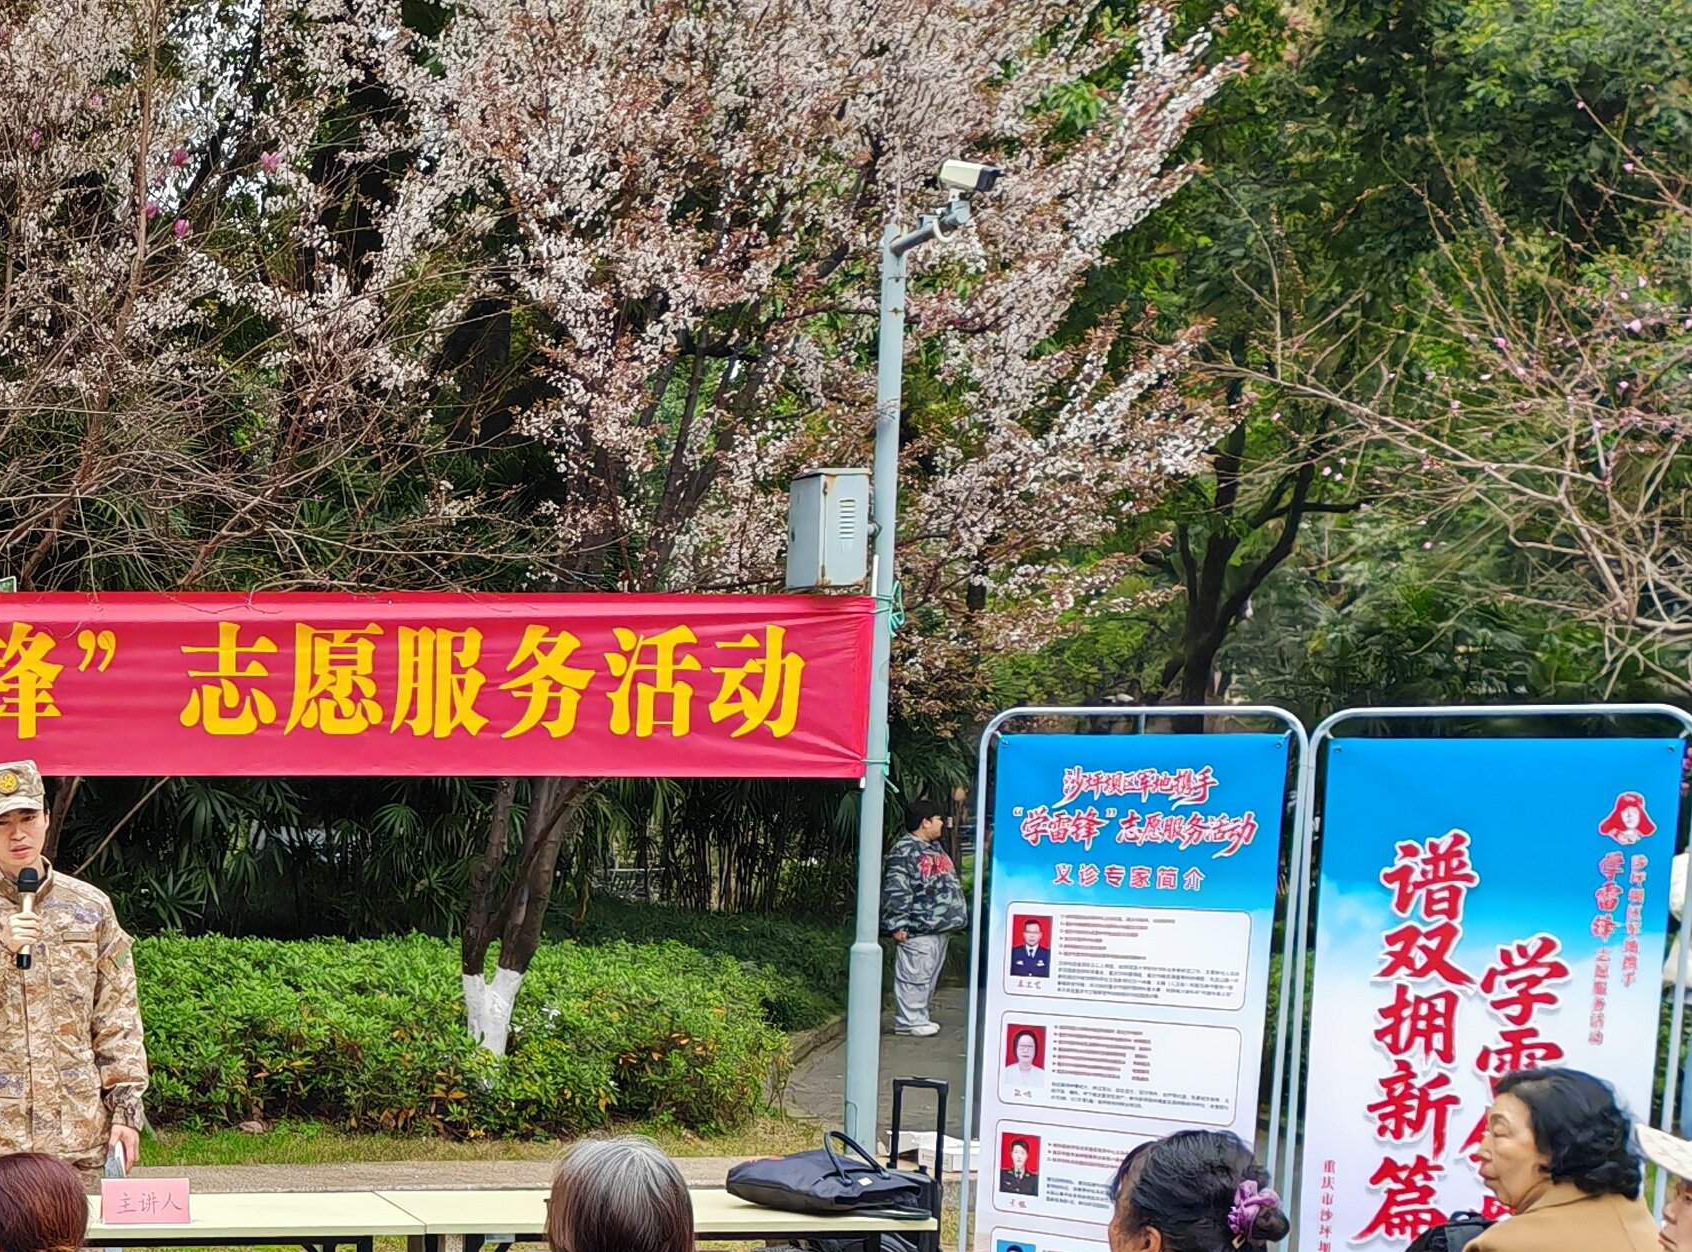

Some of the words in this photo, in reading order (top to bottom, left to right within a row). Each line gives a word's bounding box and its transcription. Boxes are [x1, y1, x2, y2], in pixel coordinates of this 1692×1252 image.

[179, 621, 806, 738] 志愿服务活动
[1052, 766, 1220, 812] 沙坪坝区军地携手
[1053, 864, 1206, 891] 义诊专家简介
[1350, 829, 1480, 1244] 谱双拥新篇
[116, 1191, 183, 1215] 主讲人
